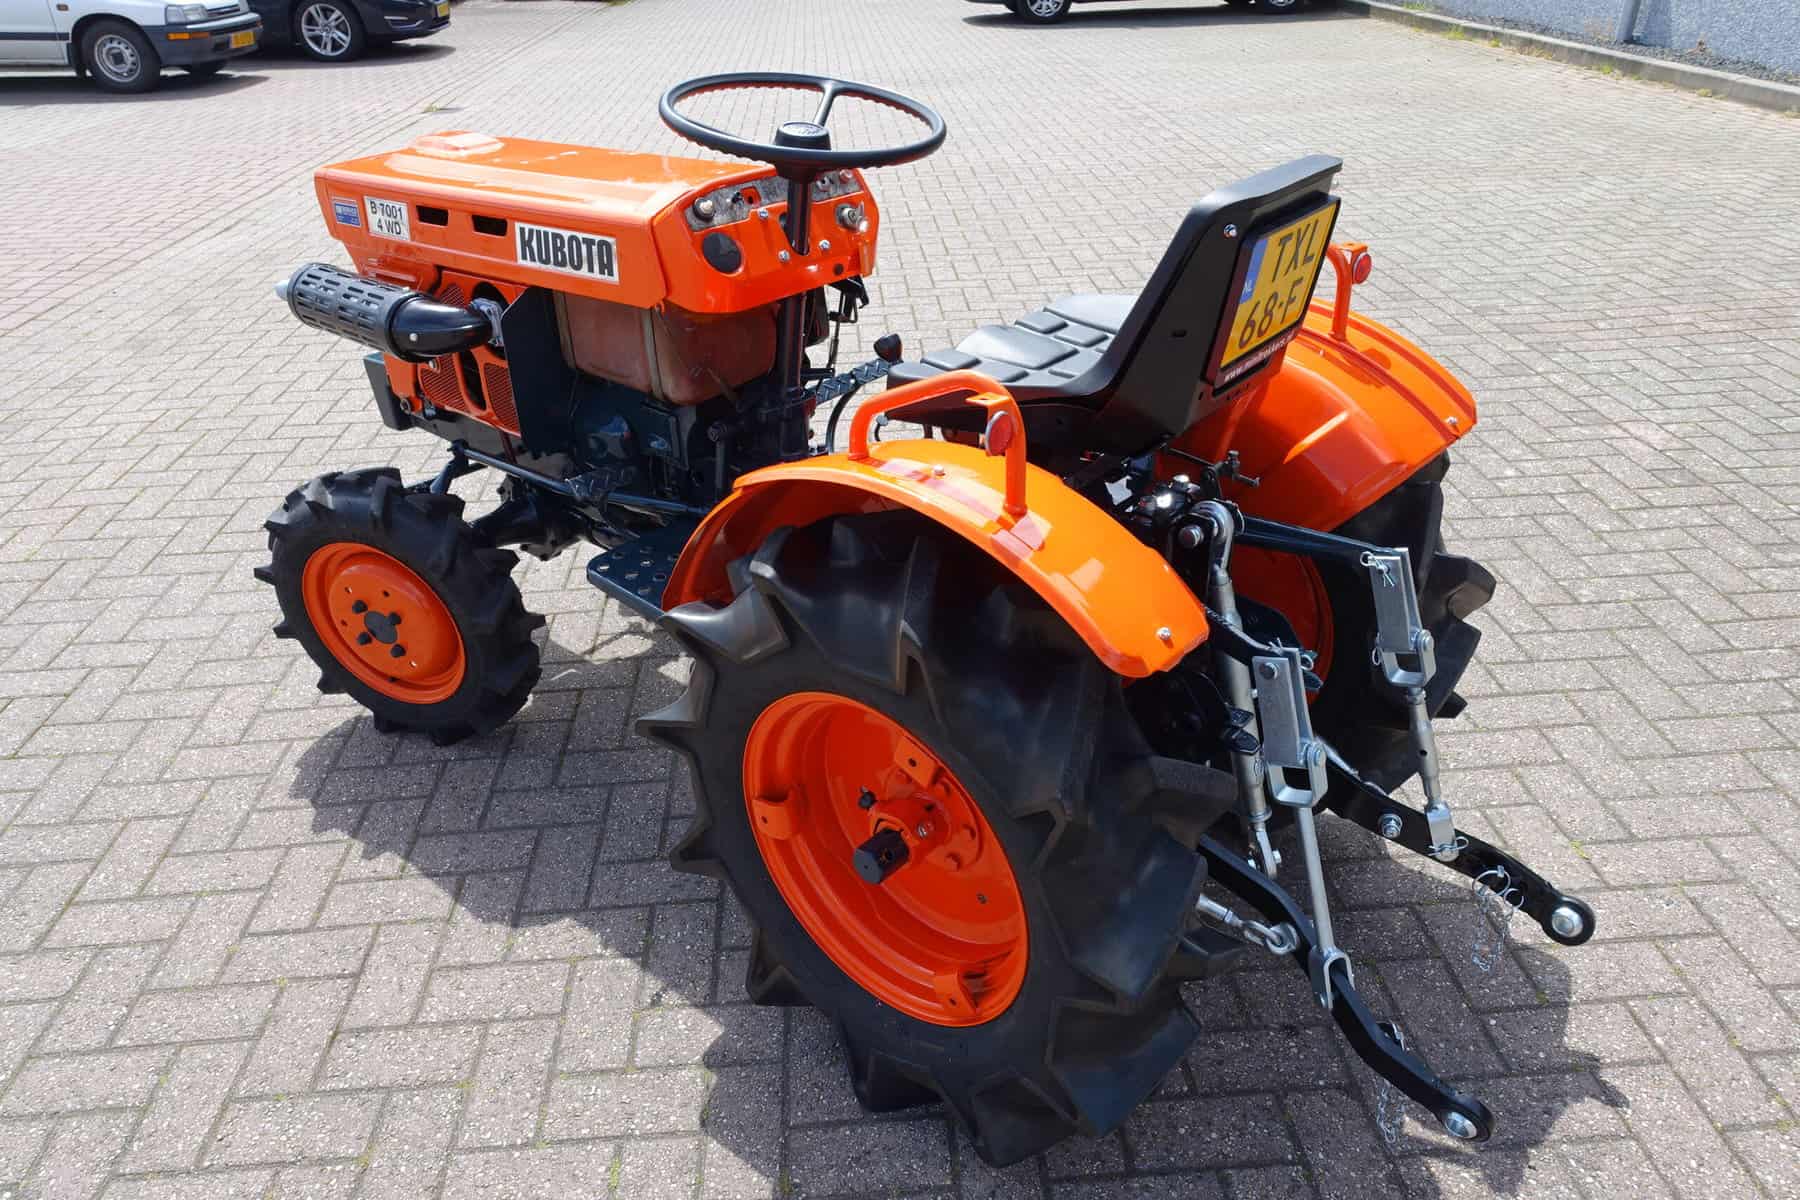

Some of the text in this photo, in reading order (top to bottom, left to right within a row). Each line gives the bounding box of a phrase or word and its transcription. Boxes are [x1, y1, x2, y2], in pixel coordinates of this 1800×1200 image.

[380, 203, 403, 219] 7001
[385, 220, 402, 235] WD
[519, 227, 614, 277] KUBOTA
[1272, 219, 1319, 283] TXL
